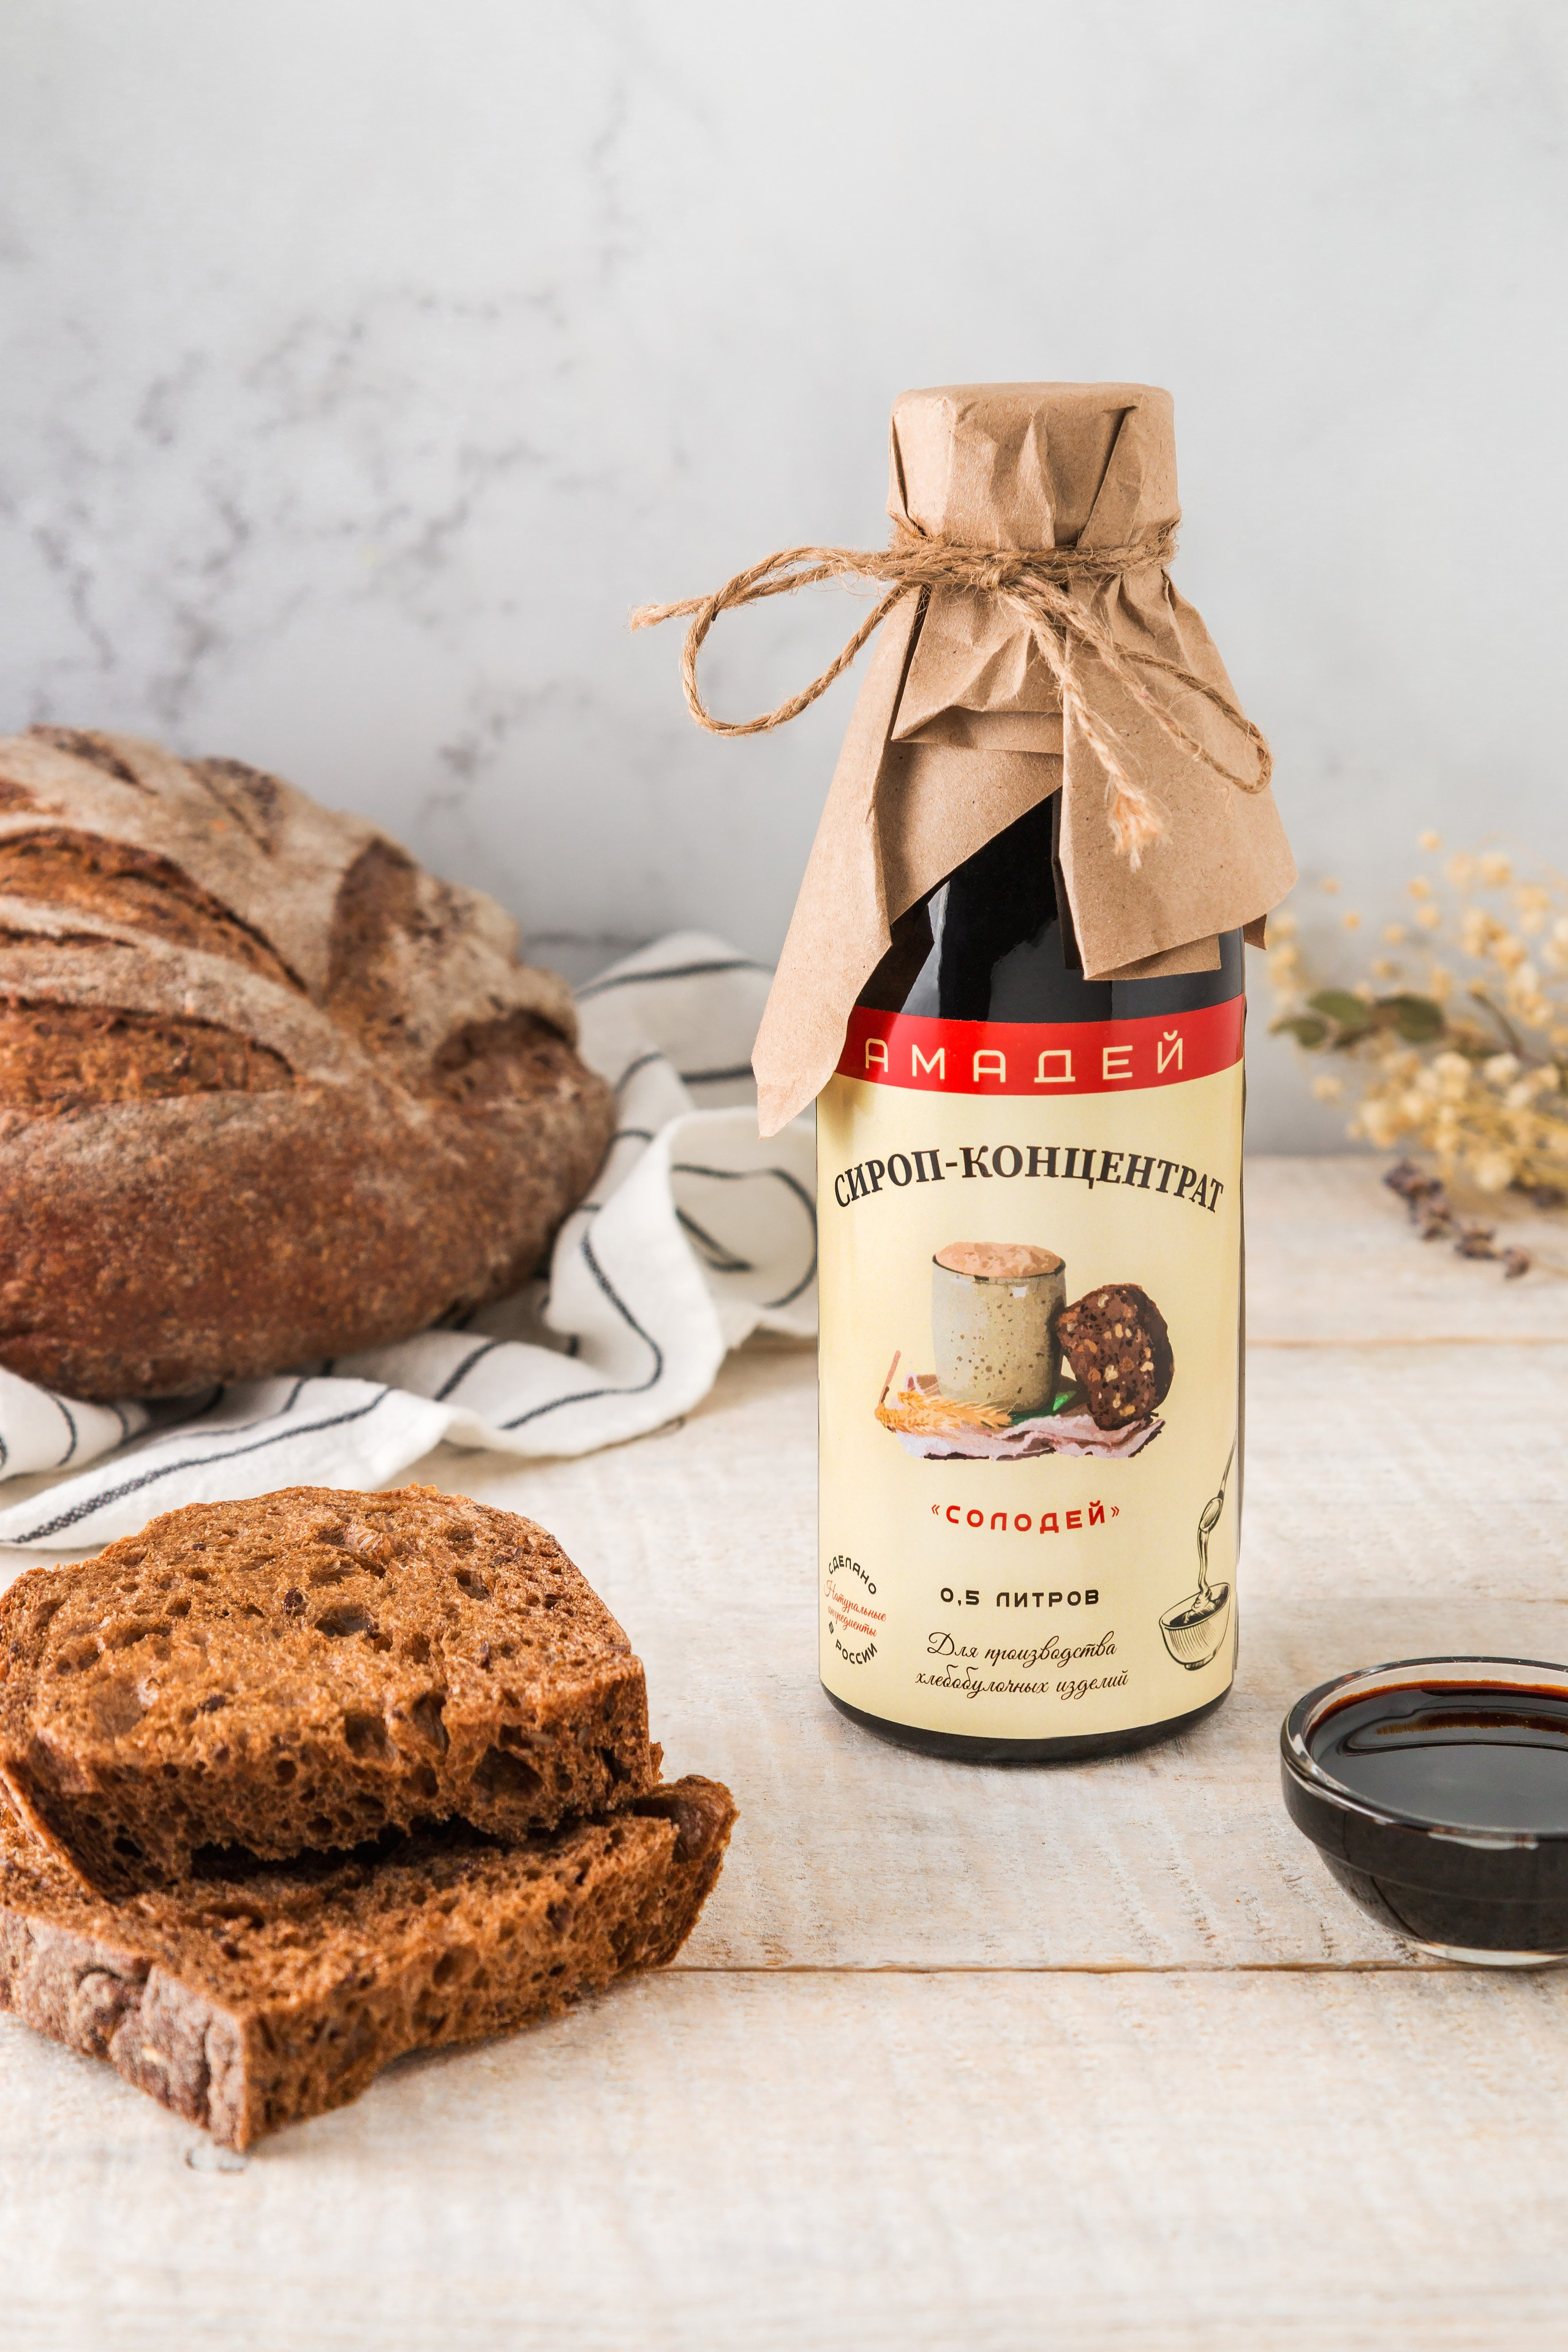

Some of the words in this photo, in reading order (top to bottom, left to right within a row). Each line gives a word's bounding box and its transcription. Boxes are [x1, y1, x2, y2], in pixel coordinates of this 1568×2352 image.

[865, 1030, 1183, 1083] АМАДЕЙ
[834, 1145, 1224, 1213] СИРОП-КОНЦЕНТРАТ
[931, 1500, 1120, 1534] «СОЛОДЕЙ»
[829, 1555, 876, 1594] СДЕЛАНО
[824, 1580, 886, 1621] Натуральные
[940, 1587, 980, 1607] 0,5
[997, 1588, 1099, 1608] ЛИТРОВ
[828, 1605, 877, 1637] ингредиенты
[829, 1621, 834, 1634] В
[835, 1638, 878, 1665] РОССИИ
[927, 1631, 978, 1659] Для
[984, 1630, 1117, 1668] производства
[915, 1664, 1049, 1698] хлебобулочных
[1056, 1670, 1128, 1700] изделий
